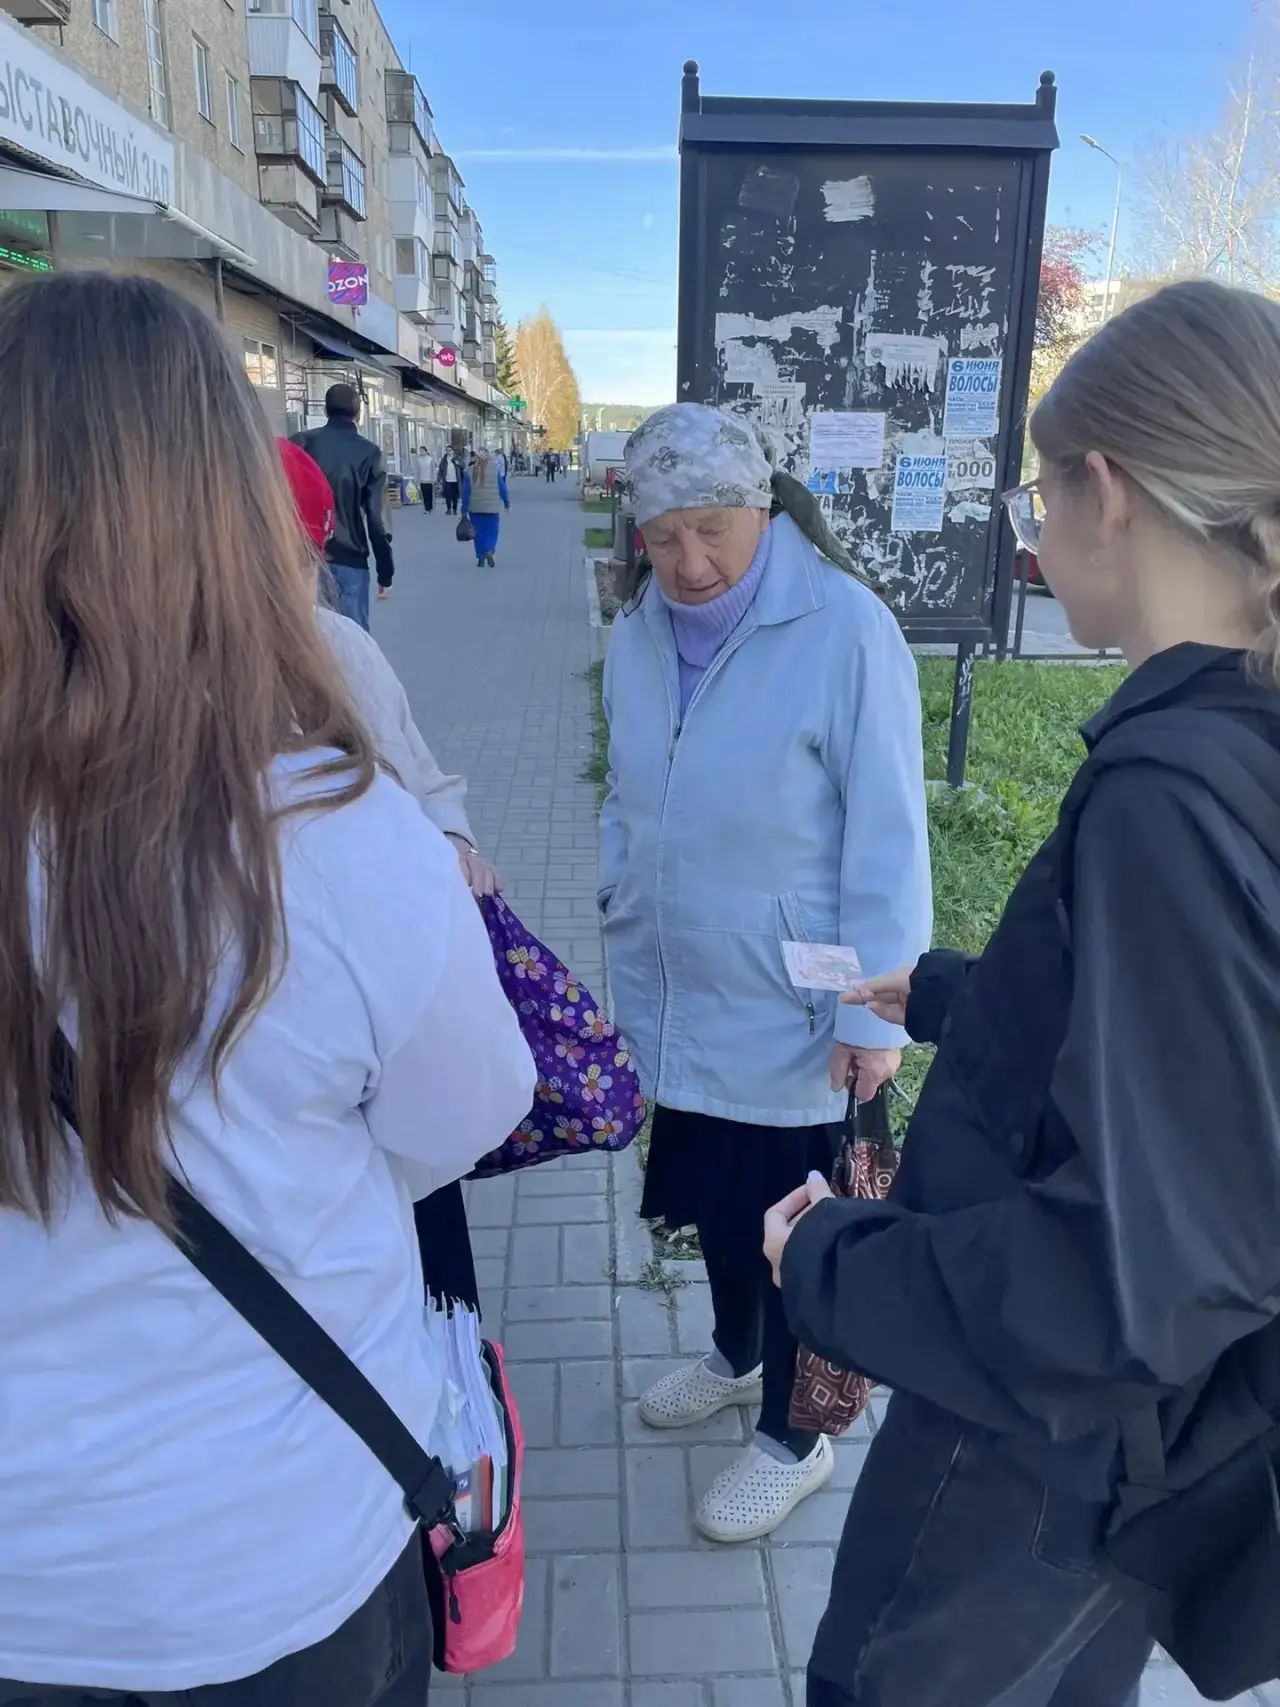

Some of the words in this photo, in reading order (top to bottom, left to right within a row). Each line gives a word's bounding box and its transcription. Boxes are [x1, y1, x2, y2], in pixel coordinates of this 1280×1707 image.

[328, 274, 368, 292] OZON
[440, 351, 453, 361] wb
[951, 360, 965, 372] 6
[966, 360, 999, 371] ИЮНЯ
[949, 375, 998, 393] ВОЛОСЫ
[899, 456, 912, 468] 6
[913, 456, 947, 467] ИЮНЯ
[896, 471, 945, 488] ВОЛОСЫ
